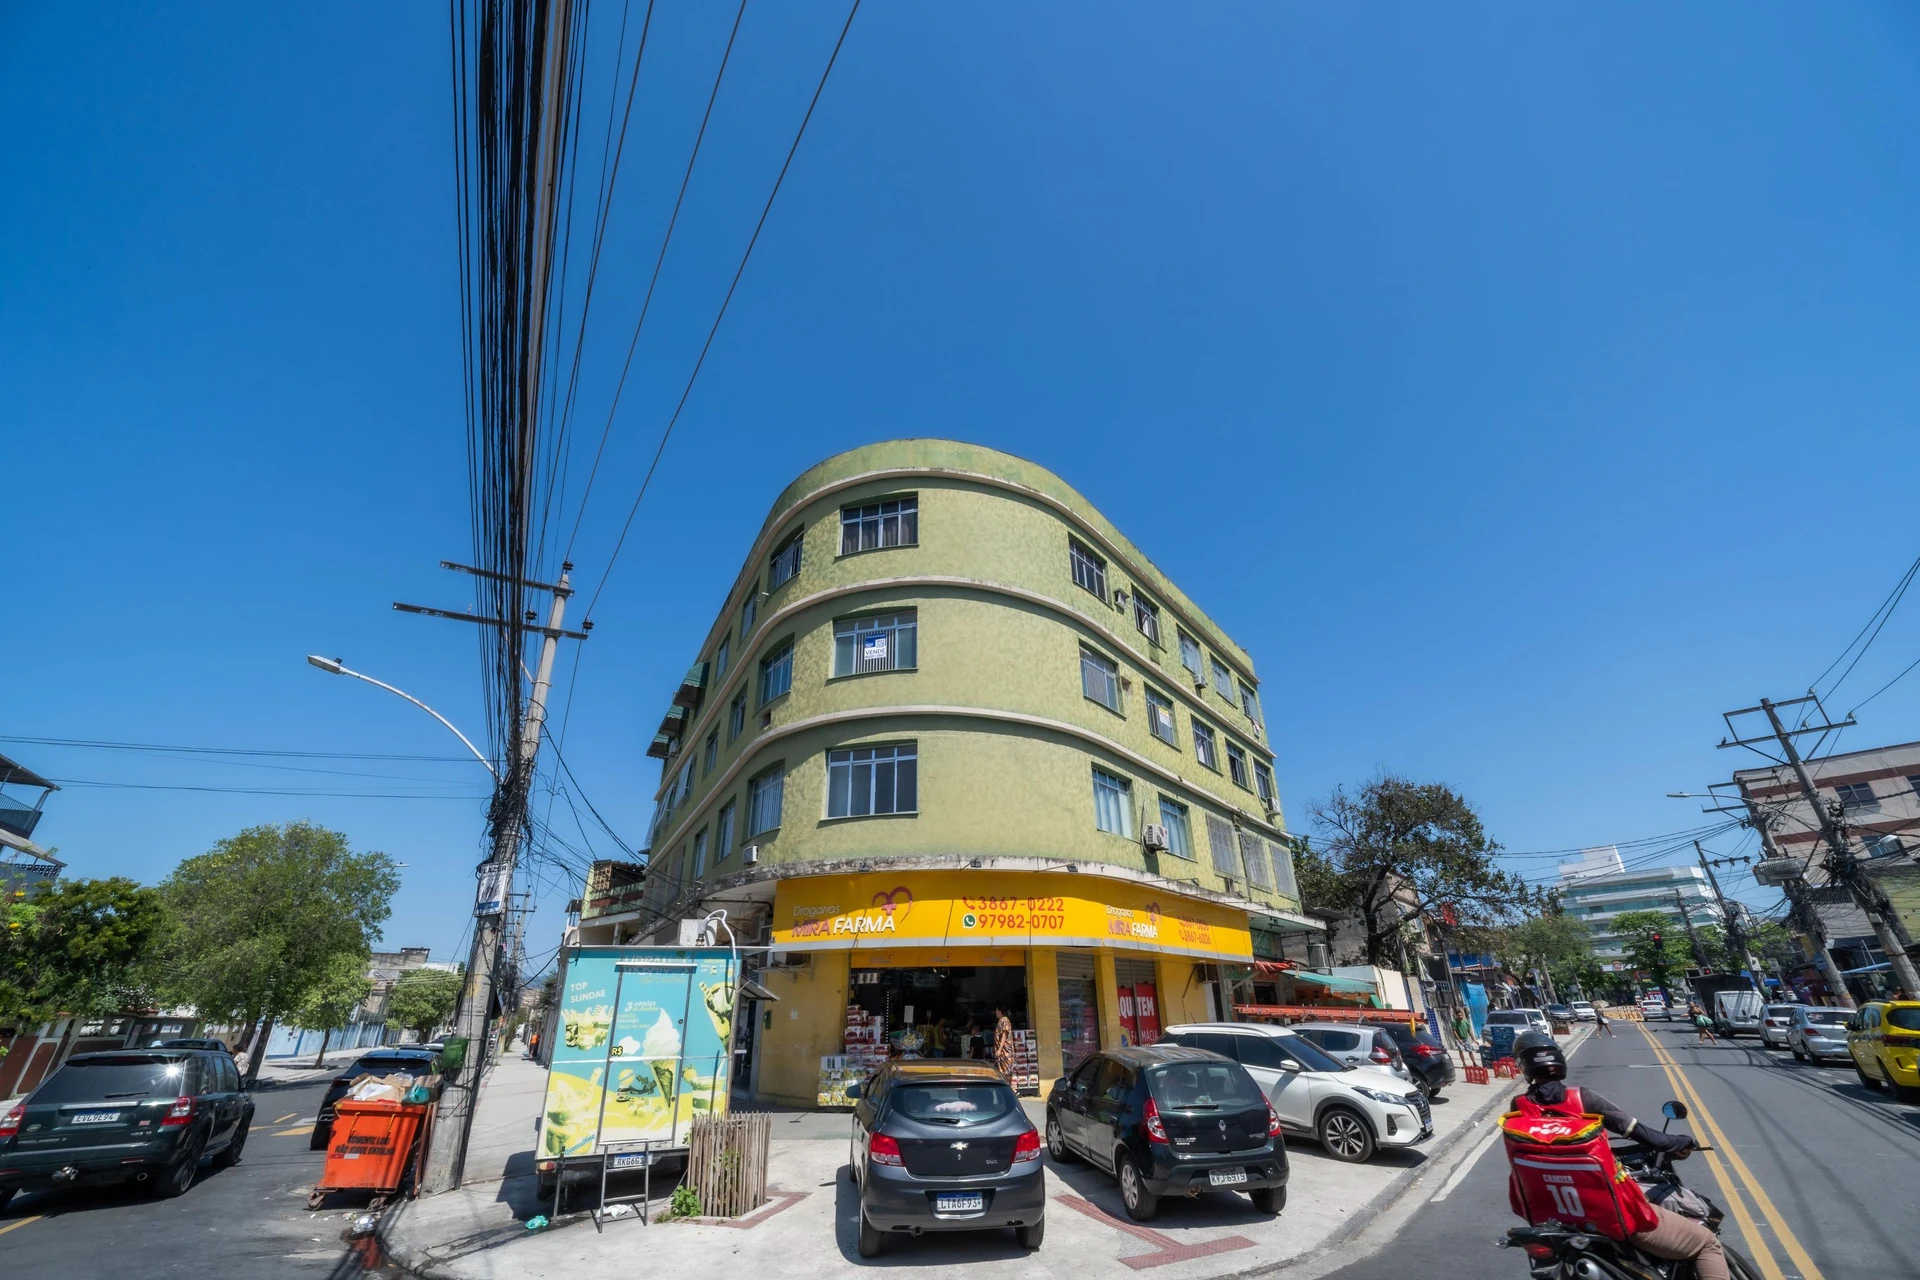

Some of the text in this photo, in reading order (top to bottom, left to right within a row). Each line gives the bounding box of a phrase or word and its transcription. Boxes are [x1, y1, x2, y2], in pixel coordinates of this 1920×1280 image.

[793, 905, 840, 917] Drogarias
[978, 896, 1064, 912] 3867-0222
[1106, 905, 1134, 918] Drogarias
[792, 915, 895, 937] MIRA FARMA
[979, 914, 1064, 929] 97982-0707
[1108, 918, 1158, 939] MIRA FARMA
[570, 982, 588, 991] TOP
[570, 989, 606, 1003] SUNDAE
[625, 1001, 633, 1012] 3
[1118, 996, 1154, 1019] QU TEM
[611, 1046, 623, 1056] R$
[617, 1156, 645, 1166] RKG6G1
[1546, 1184, 1585, 1217] 10
